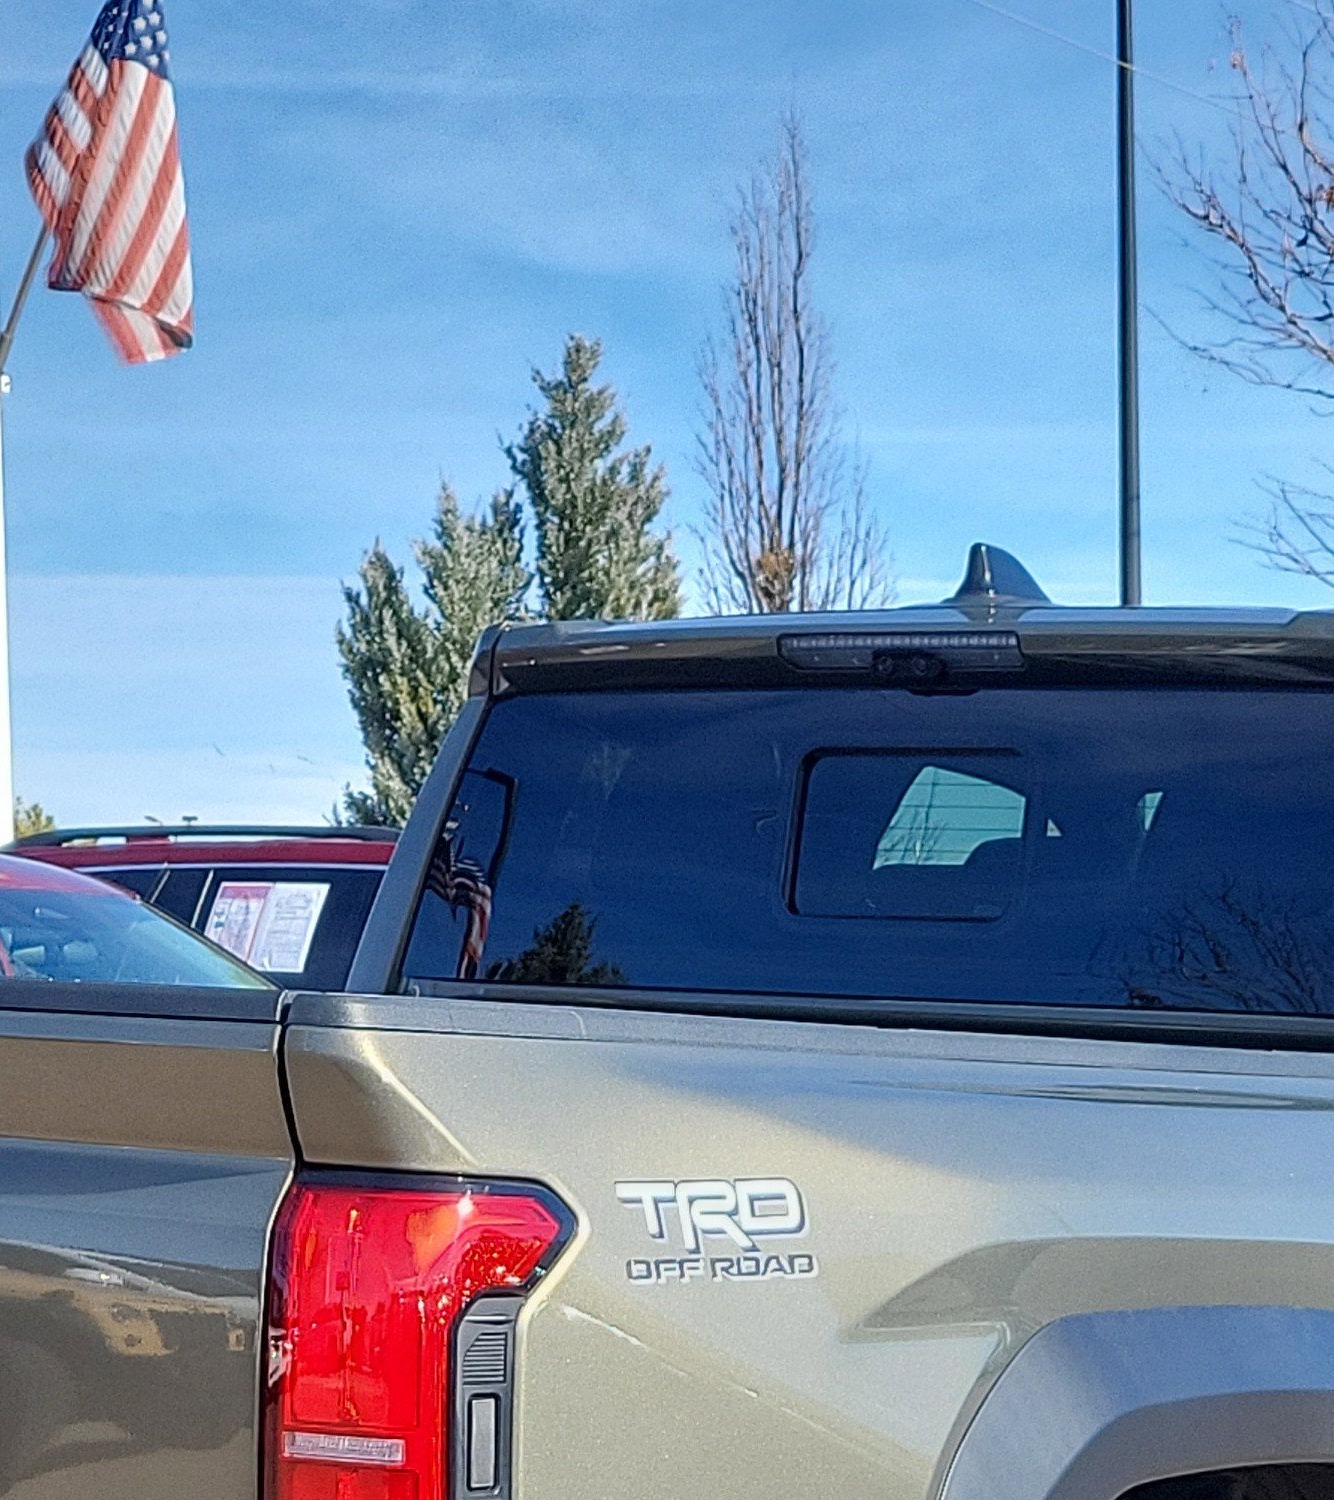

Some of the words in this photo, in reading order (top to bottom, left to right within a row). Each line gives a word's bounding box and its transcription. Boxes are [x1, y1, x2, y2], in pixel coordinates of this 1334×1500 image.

[614, 1177, 808, 1253] TRD
[625, 1257, 703, 1283] OFF
[709, 1253, 816, 1282] ROAD
